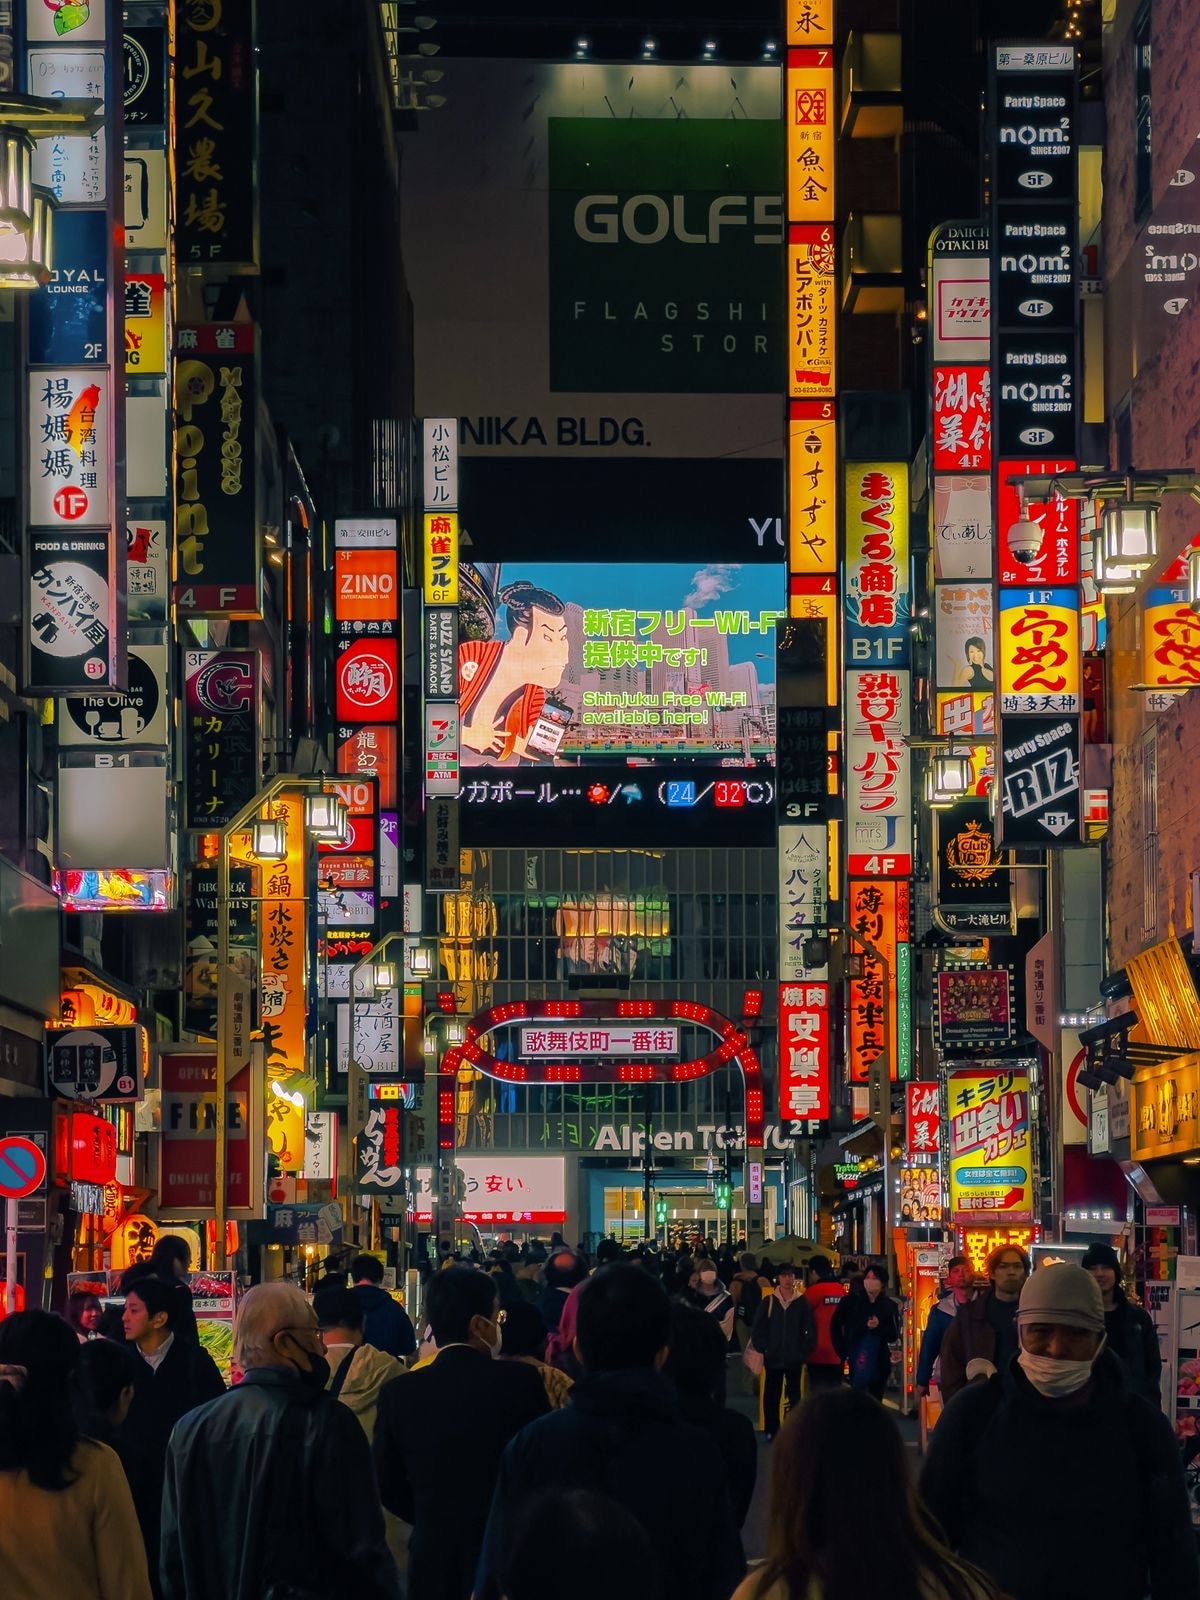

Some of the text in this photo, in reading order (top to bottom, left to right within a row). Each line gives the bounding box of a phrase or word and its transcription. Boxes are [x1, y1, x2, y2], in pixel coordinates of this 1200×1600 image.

[795, 5, 827, 34] 永
[818, 51, 828, 65] 7
[998, 53, 1073, 66] 第一桑原ビル
[1005, 96, 1066, 108] Party Space
[800, 131, 823, 141] 新宿
[1031, 146, 1071, 155] SINCE 2007
[796, 146, 828, 201] 魚金
[1027, 174, 1045, 186] 5F
[821, 228, 831, 242] 6
[1005, 225, 1066, 237] Party Space
[977, 239, 990, 250] BI
[50, 270, 104, 282] OYAL
[814, 279, 832, 287] with
[1031, 274, 1071, 283] SINCE 2007
[47, 285, 88, 293] LOUNGE
[124, 281, 152, 318] 雀
[574, 301, 767, 321] FLAGSHI
[1027, 302, 1044, 314] 4F
[818, 286, 828, 356] ダーツ カラオケ
[177, 329, 236, 349] 麻雀
[660, 334, 768, 353] STOR
[84, 344, 102, 358] 2F
[1006, 353, 1067, 365] Party Space
[821, 403, 832, 417] 5
[1032, 403, 1072, 412] SINCE 2007
[41, 378, 73, 480] 楊媽媽
[556, 416, 652, 447] BLDG.
[1028, 431, 1046, 443] 3F
[79, 406, 98, 489] 台湾料理
[432, 424, 450, 502] 小松ビル
[958, 455, 982, 467] 4F
[56, 495, 86, 515] 1F
[800, 460, 827, 563] すずや
[35, 543, 106, 551] FOOD & DRINKS
[429, 516, 452, 588] 麻雀ブル
[859, 472, 896, 628] まぐろ商店
[1055, 538, 1069, 578] ホステル
[341, 574, 393, 594] ZINO
[1002, 571, 1017, 582] 2F
[821, 579, 832, 593] 4
[65, 575, 101, 613] 新宿酒場
[432, 590, 450, 601] 6F
[1027, 590, 1053, 605] 1F
[32, 566, 108, 646] カンパイ屋
[429, 613, 438, 640] DARTS
[582, 609, 786, 636] 新宿フリーWi-F
[338, 641, 351, 650] 4F
[852, 638, 904, 660] B1F
[188, 654, 207, 666] 3F
[440, 612, 453, 695] BUZZ STAND
[87, 663, 104, 674] B1
[429, 651, 438, 695] KARAOKE
[107, 697, 144, 707] Olive
[582, 691, 747, 708] Shinjuku Free Wi-Fi
[1003, 694, 1076, 711] 博多天神
[582, 711, 710, 725] available here!
[339, 728, 353, 739] 3F
[1004, 722, 1073, 764] Party Space
[95, 753, 130, 768] B1
[205, 716, 224, 815] カリーナ
[433, 771, 452, 779] ATM
[786, 803, 820, 817] 3F
[380, 818, 398, 833] 2F
[1047, 814, 1067, 827] B1
[864, 856, 896, 874] 4F
[361, 892, 374, 902] 2F
[784, 869, 809, 950] バンタイ
[946, 914, 1009, 927] 第一大滝ビル
[268, 903, 294, 970] 水炊き
[795, 968, 812, 978] 3F
[782, 987, 826, 1007] 焼肉
[526, 1031, 675, 1053] 歌舞伎町一番街
[788, 1011, 821, 1115] 安楽亭
[118, 1080, 133, 1089] B1
[956, 1070, 1015, 1108] キラリ
[911, 1086, 939, 1117] 湖
[789, 1119, 820, 1135] 2F
[955, 1094, 1023, 1152] 出会い
[594, 1125, 694, 1157] Alpen
[910, 1120, 939, 1150] 菜
[983, 1128, 1027, 1165] カフェ
[959, 1198, 1006, 1209] 受付3F
